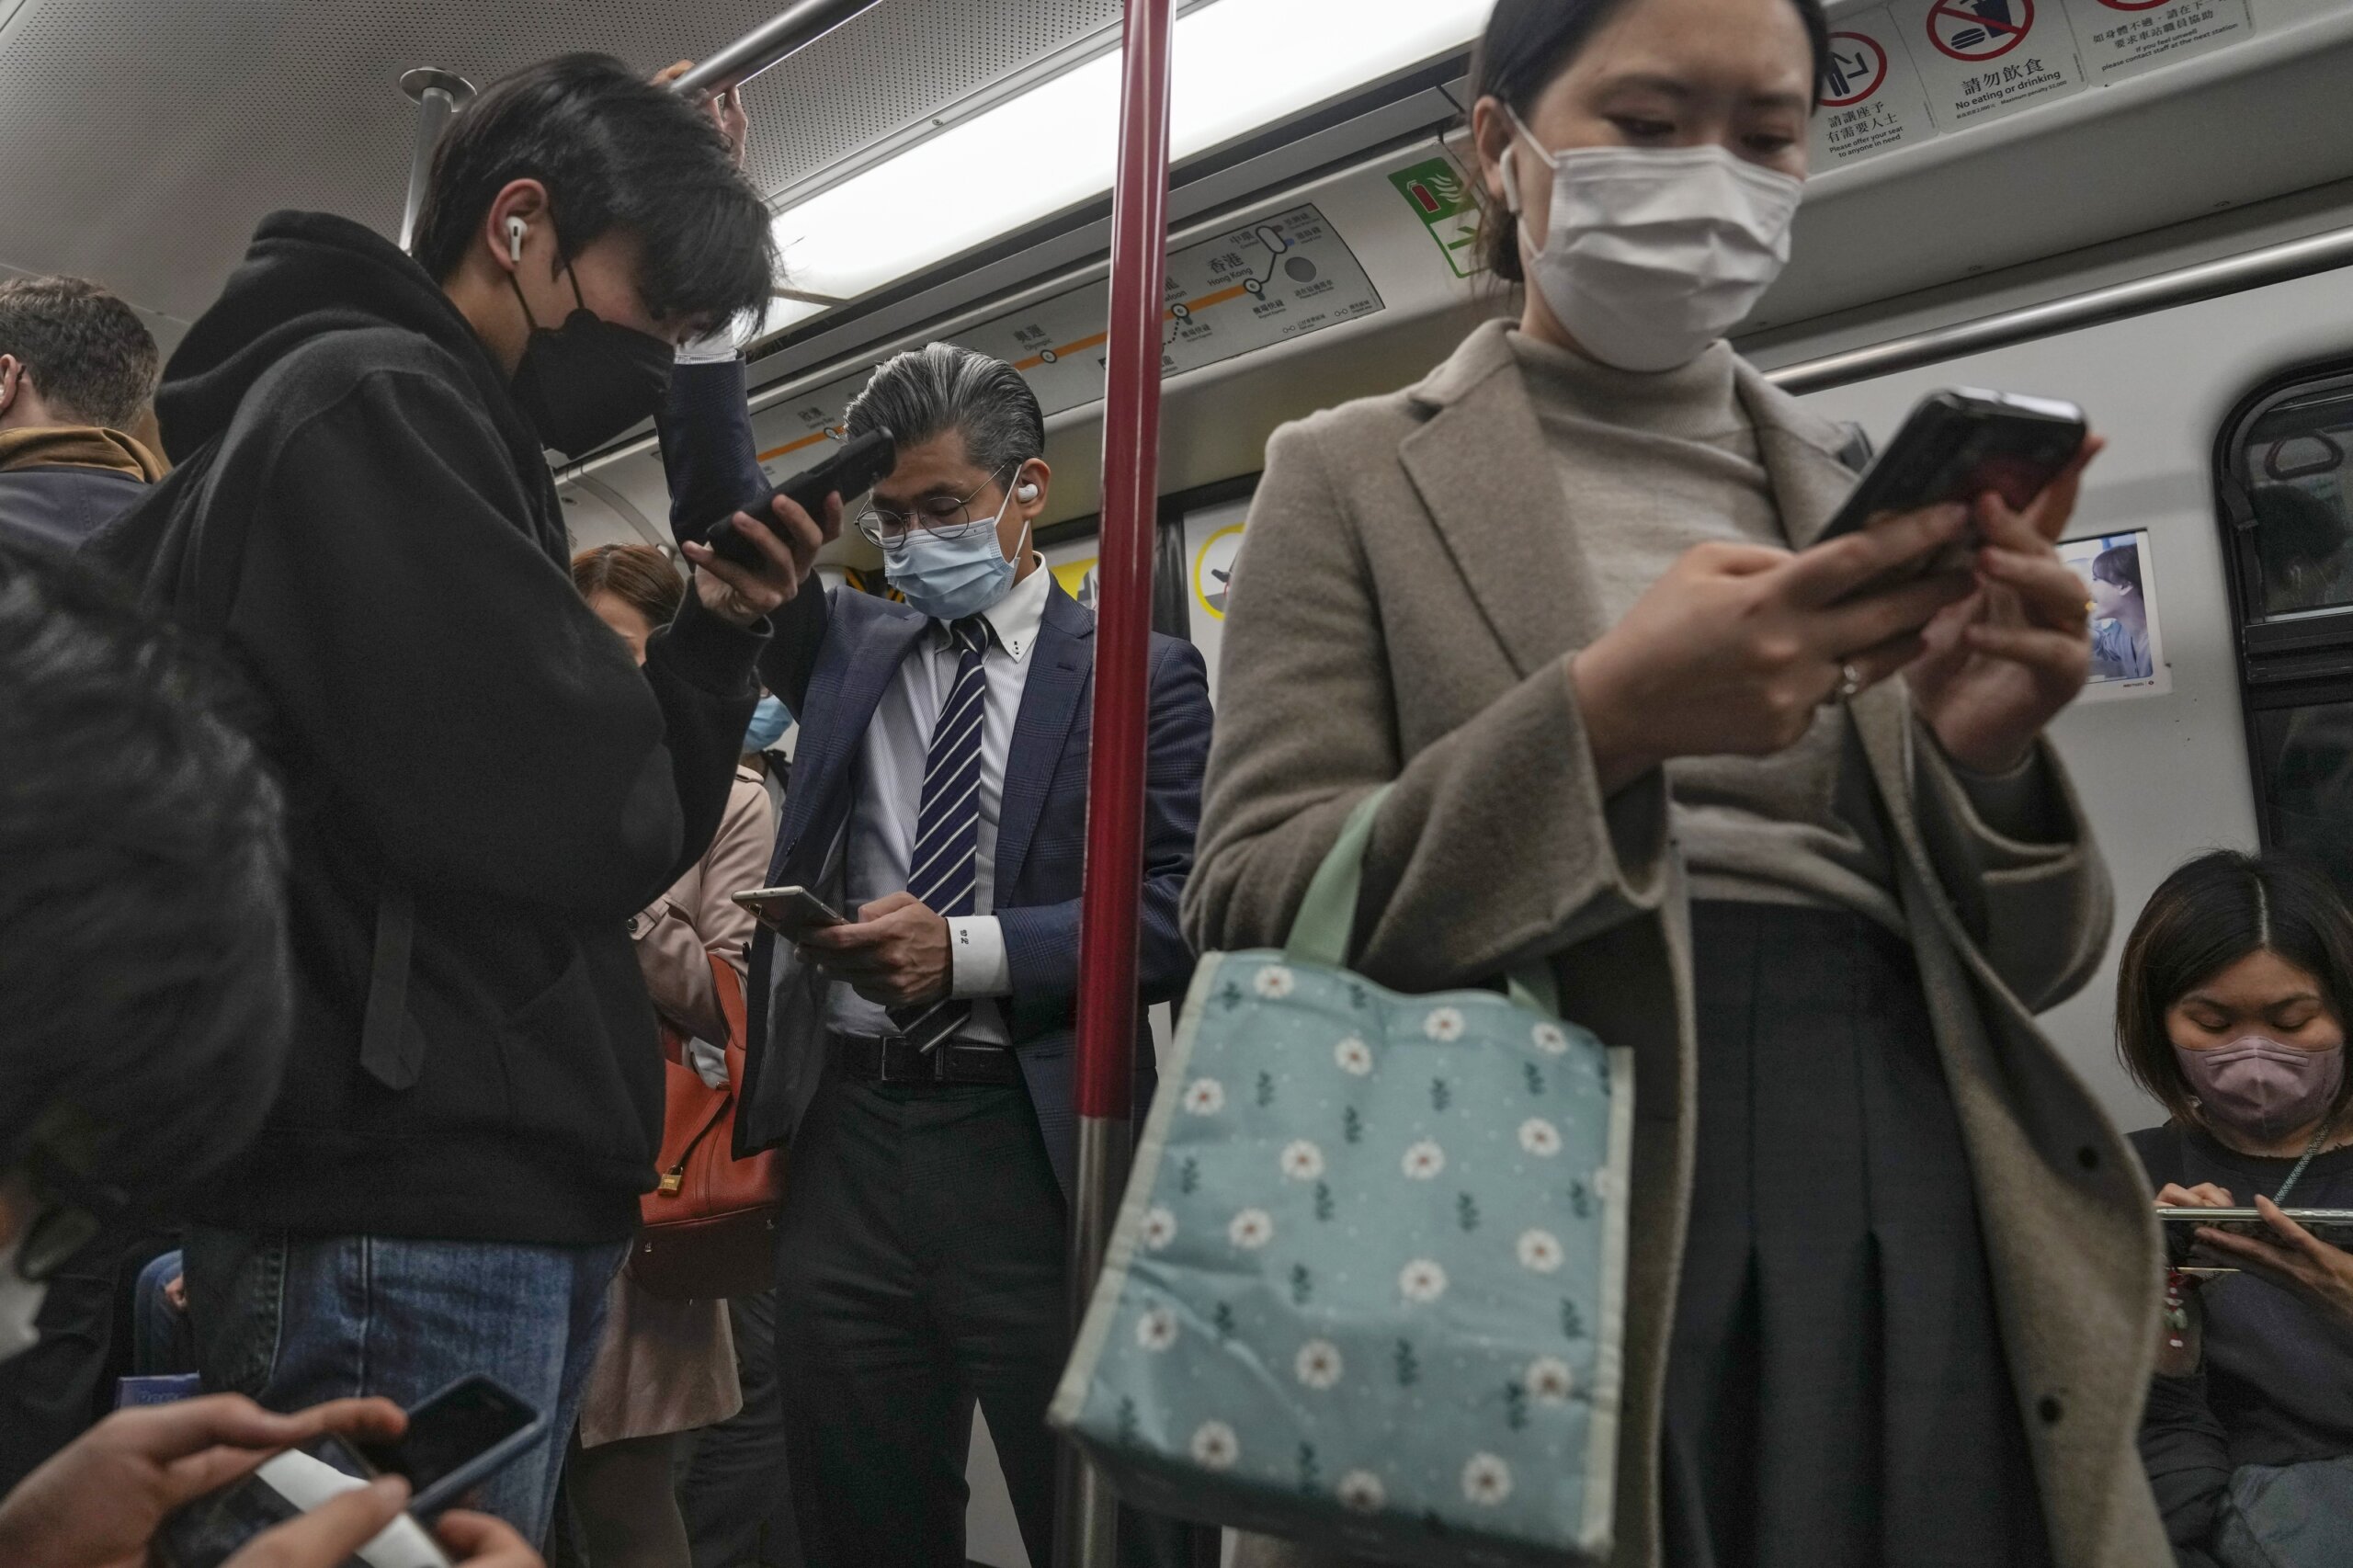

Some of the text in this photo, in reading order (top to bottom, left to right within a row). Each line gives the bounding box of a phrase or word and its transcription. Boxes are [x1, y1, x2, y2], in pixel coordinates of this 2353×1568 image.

[2101, 59, 2124, 73] please
[2125, 51, 2153, 63] contact
[2153, 44, 2170, 55] staff
[2179, 38, 2192, 47] the
[2193, 32, 2211, 42] next
[2211, 23, 2239, 37] station
[2143, 42, 2156, 52] you
[2157, 37, 2171, 47] feel
[2172, 28, 2198, 41] unwell
[1955, 71, 2062, 110] No eating or drinking
[1961, 58, 2045, 97] 請勿飲食
[1825, 111, 1898, 143] 有需要人士
[1827, 100, 1884, 129] 請讓座予
[1829, 126, 1904, 153] Please offer your seat
[1847, 143, 1873, 155] anyone
[1882, 133, 1901, 143] need
[1207, 252, 1245, 274] 香港
[1207, 267, 1254, 287] Hong Kong
